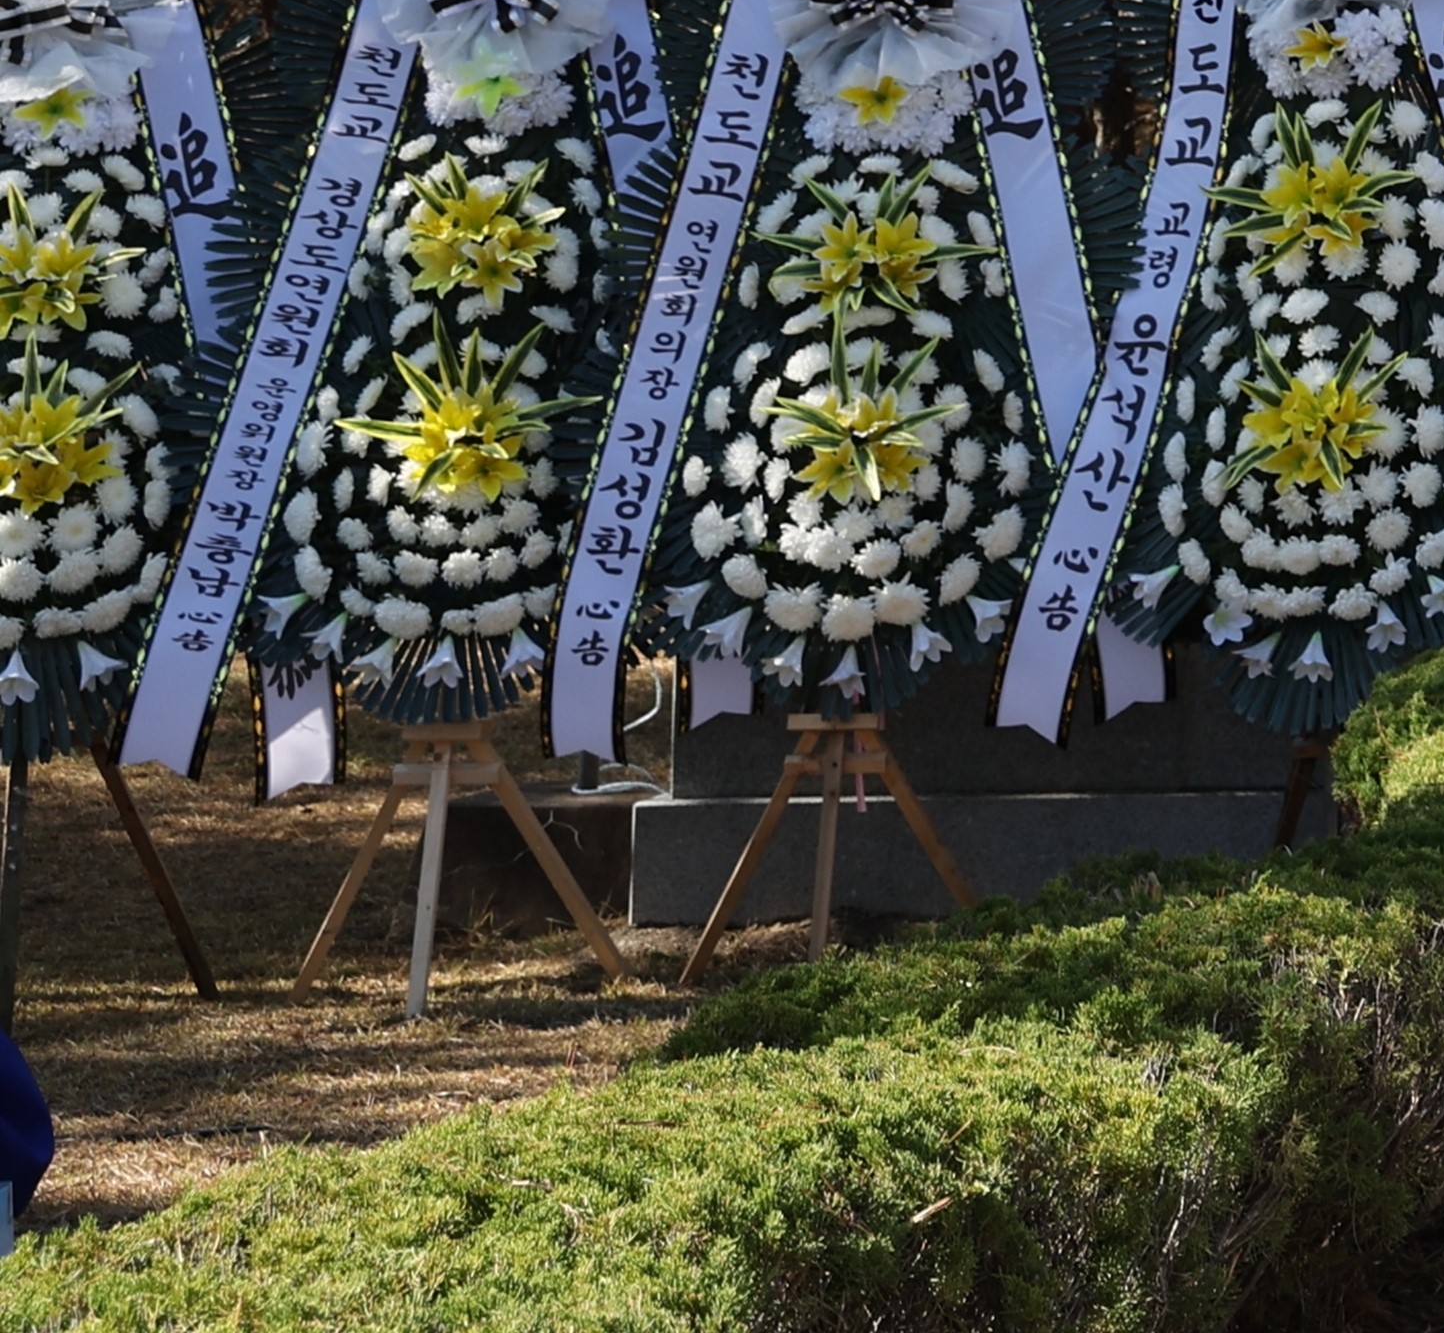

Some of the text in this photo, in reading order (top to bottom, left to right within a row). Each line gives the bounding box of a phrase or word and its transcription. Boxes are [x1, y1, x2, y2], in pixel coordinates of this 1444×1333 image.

[333, 44, 402, 144] 천도교
[595, 33, 666, 143] 追
[976, 48, 1044, 141] 追
[159, 111, 238, 221] 追
[257, 176, 364, 370] 경상도연원회
[1147, 201, 1192, 290] 교령
[584, 52, 770, 576] 천도교 연원회의장 김성환
[1073, 314, 1167, 513] 윤석산
[187, 500, 262, 599] 박충남
